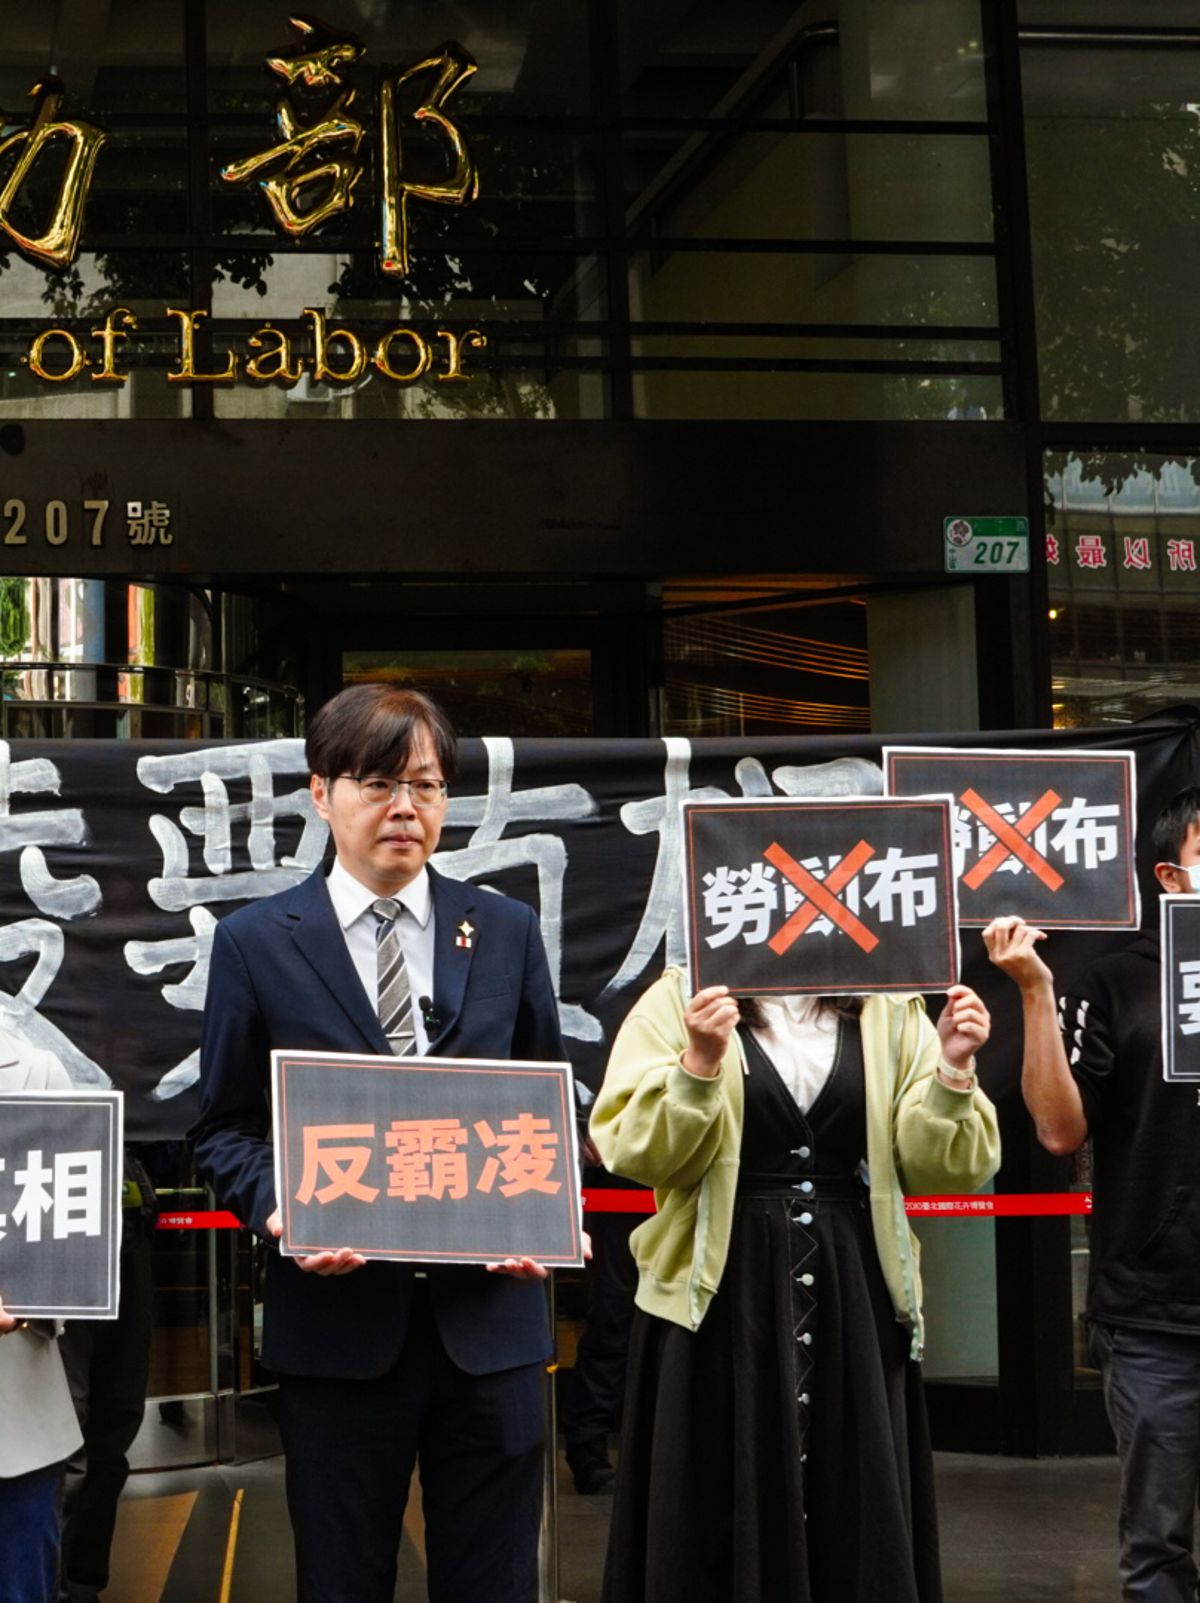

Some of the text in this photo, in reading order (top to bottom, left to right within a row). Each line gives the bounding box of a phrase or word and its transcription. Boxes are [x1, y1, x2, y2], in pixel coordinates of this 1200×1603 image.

[29, 307, 136, 382] of
[167, 307, 488, 382] Labor
[973, 541, 1020, 564] 207
[295, 1113, 562, 1205] 反霸凌
